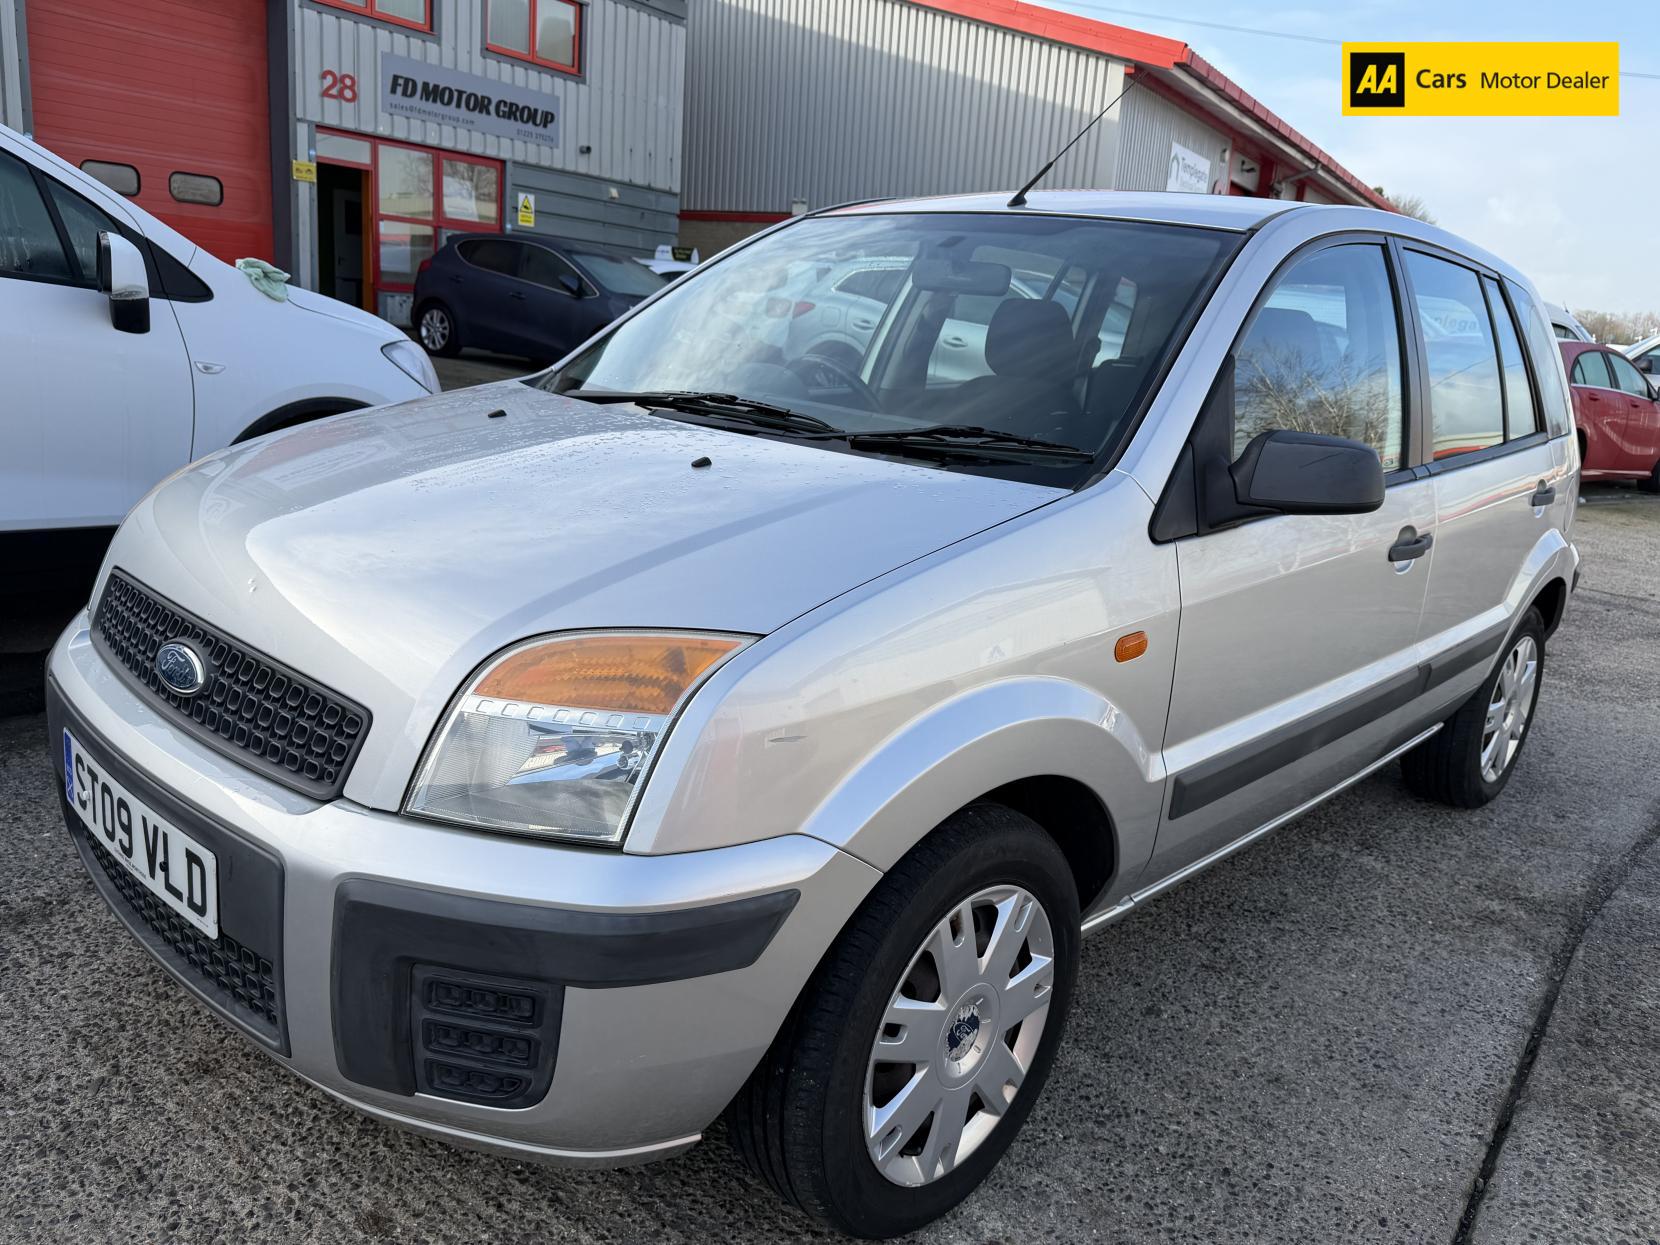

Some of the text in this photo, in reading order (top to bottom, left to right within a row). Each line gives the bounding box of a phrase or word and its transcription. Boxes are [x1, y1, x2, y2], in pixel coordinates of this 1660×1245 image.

[320, 69, 357, 104] 28
[390, 74, 555, 129] FD MOTOR GROUP
[160, 649, 196, 686] Ford
[75, 753, 207, 918] ST09 VLD
